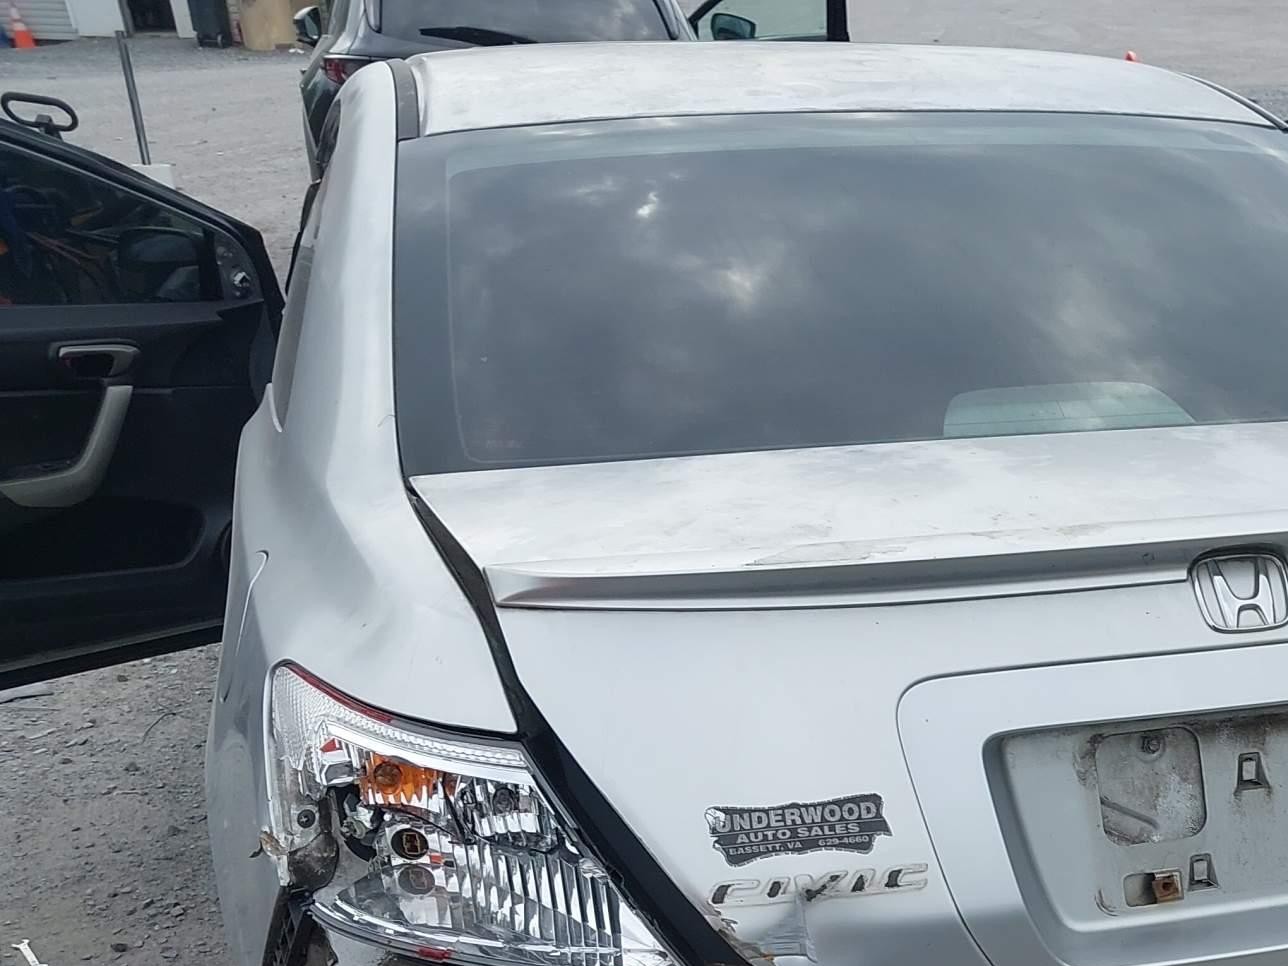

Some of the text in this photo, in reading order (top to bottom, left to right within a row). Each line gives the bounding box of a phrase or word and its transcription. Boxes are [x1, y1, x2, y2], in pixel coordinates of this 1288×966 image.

[715, 802, 877, 833] UNDERWOOD
[736, 822, 860, 844] AUTO SALES
[787, 841, 803, 849] VA
[710, 863, 928, 906] CIVIC
